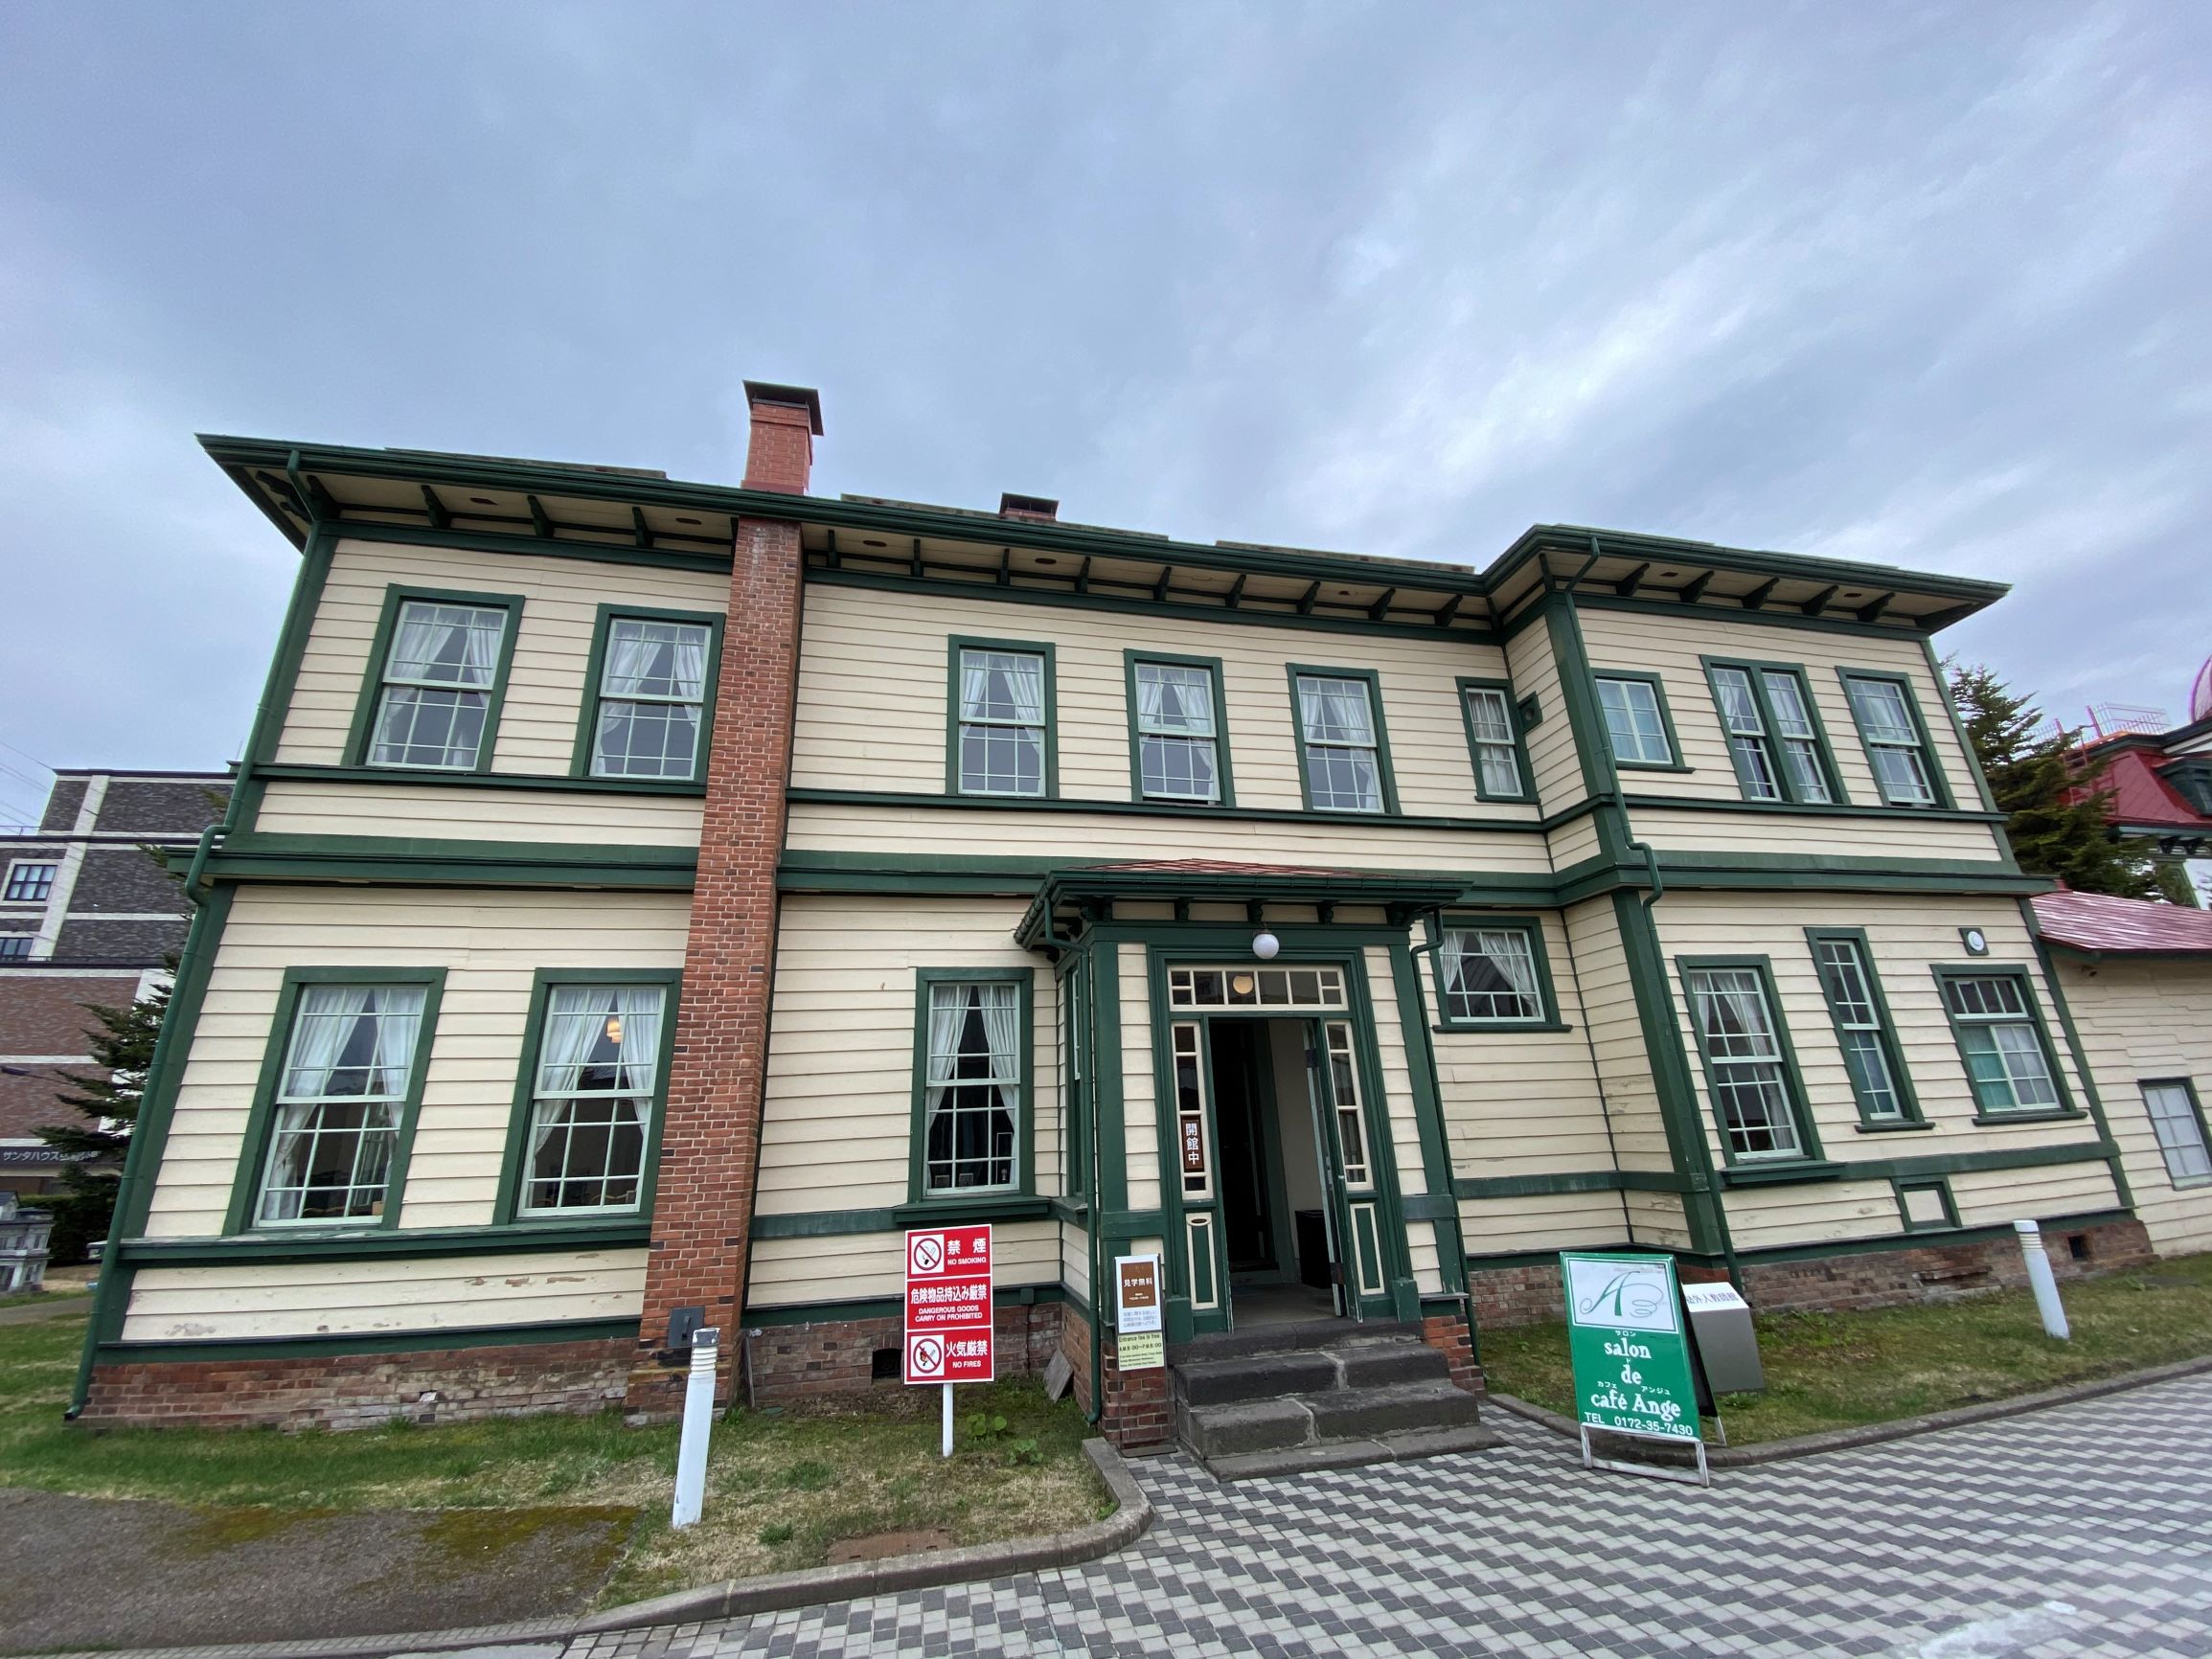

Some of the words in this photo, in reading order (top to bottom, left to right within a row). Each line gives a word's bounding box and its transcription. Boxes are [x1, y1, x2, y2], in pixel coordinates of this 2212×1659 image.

[1185, 1123, 1199, 1166] 開館中
[3, 1151, 101, 1162] サンタハウス
[947, 1238, 987, 1256] 禁煙
[1124, 1277, 1153, 1287] 見学無料
[911, 1284, 988, 1305] 危険物品持込み厳禁
[946, 1312, 983, 1321] PROHIBITED
[946, 1340, 988, 1357] 火気厳禁
[1604, 1337, 1652, 1359] salon
[1621, 1364, 1642, 1384] de
[1597, 1380, 1617, 1389] カフェ
[1641, 1385, 1671, 1396] アンジュ
[1590, 1389, 1628, 1410] café
[1631, 1393, 1681, 1421] Ange
[1585, 1411, 1606, 1424] TEL
[1614, 1416, 1694, 1436] 0172-35-7430
